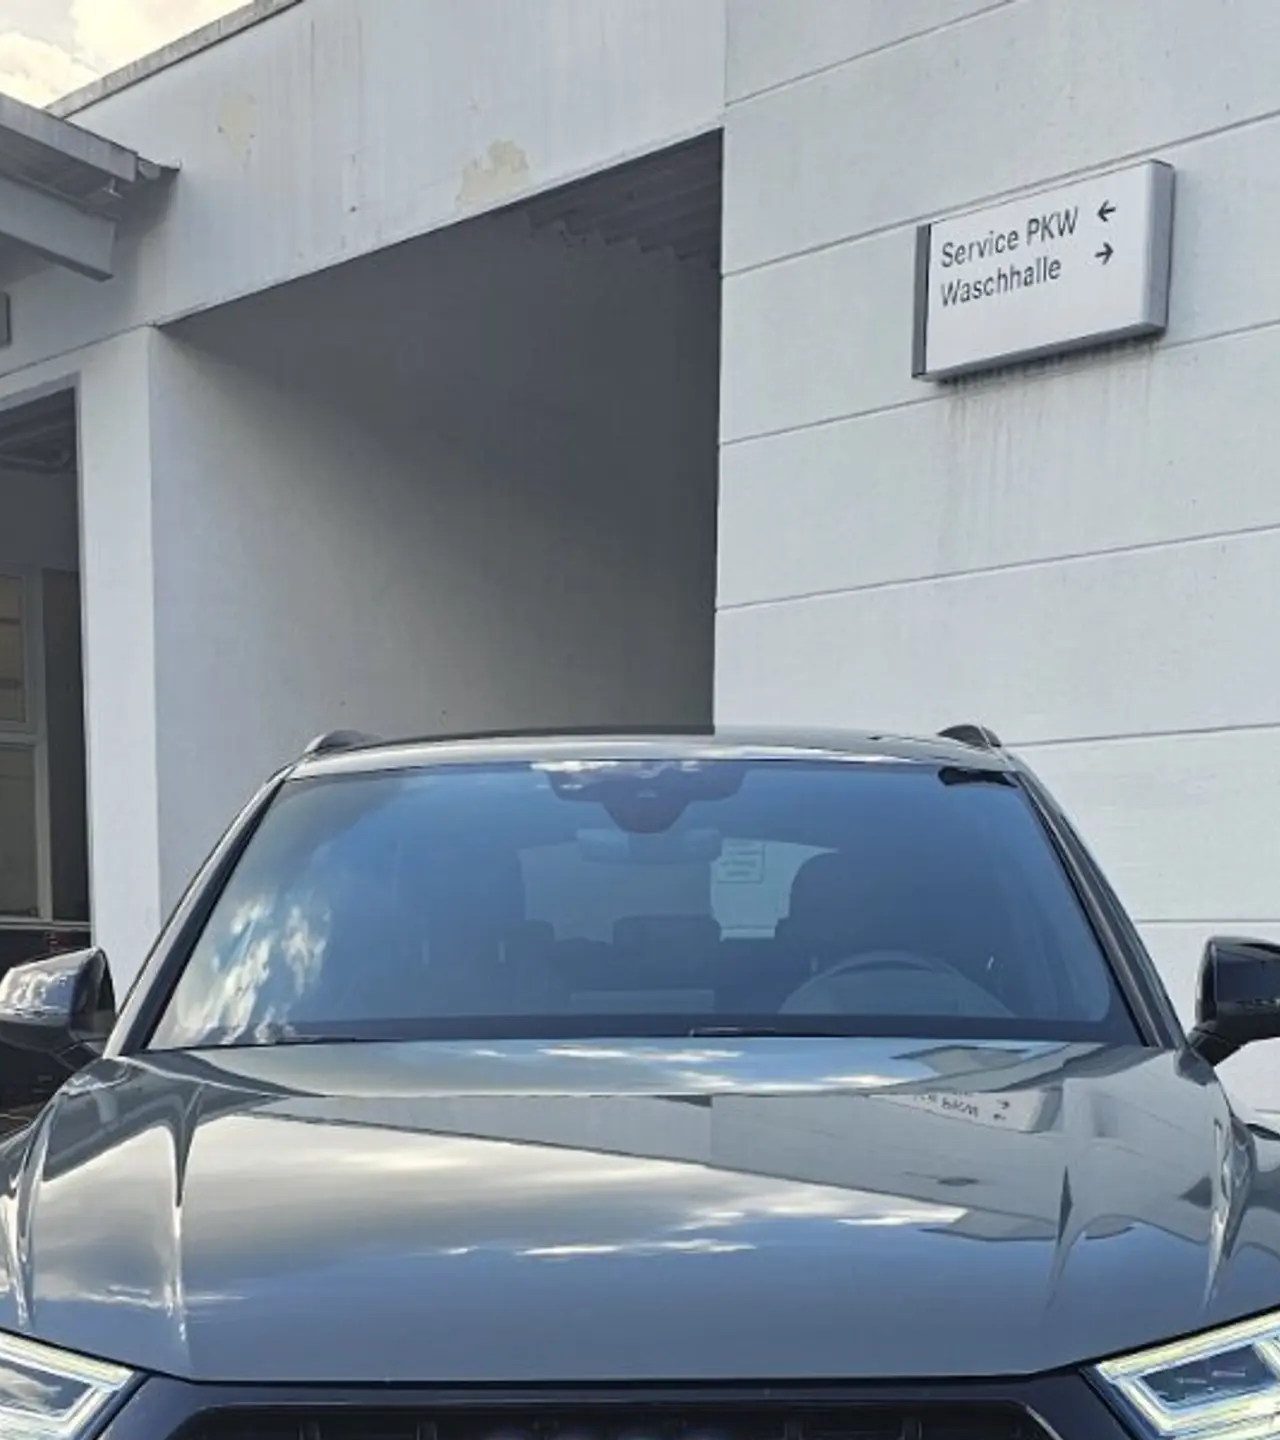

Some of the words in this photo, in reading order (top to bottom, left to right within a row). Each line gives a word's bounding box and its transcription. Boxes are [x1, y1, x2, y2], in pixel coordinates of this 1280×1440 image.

[941, 230, 1019, 268] Service
[1026, 206, 1079, 246] PKW
[940, 257, 1062, 307] Waschhalle
